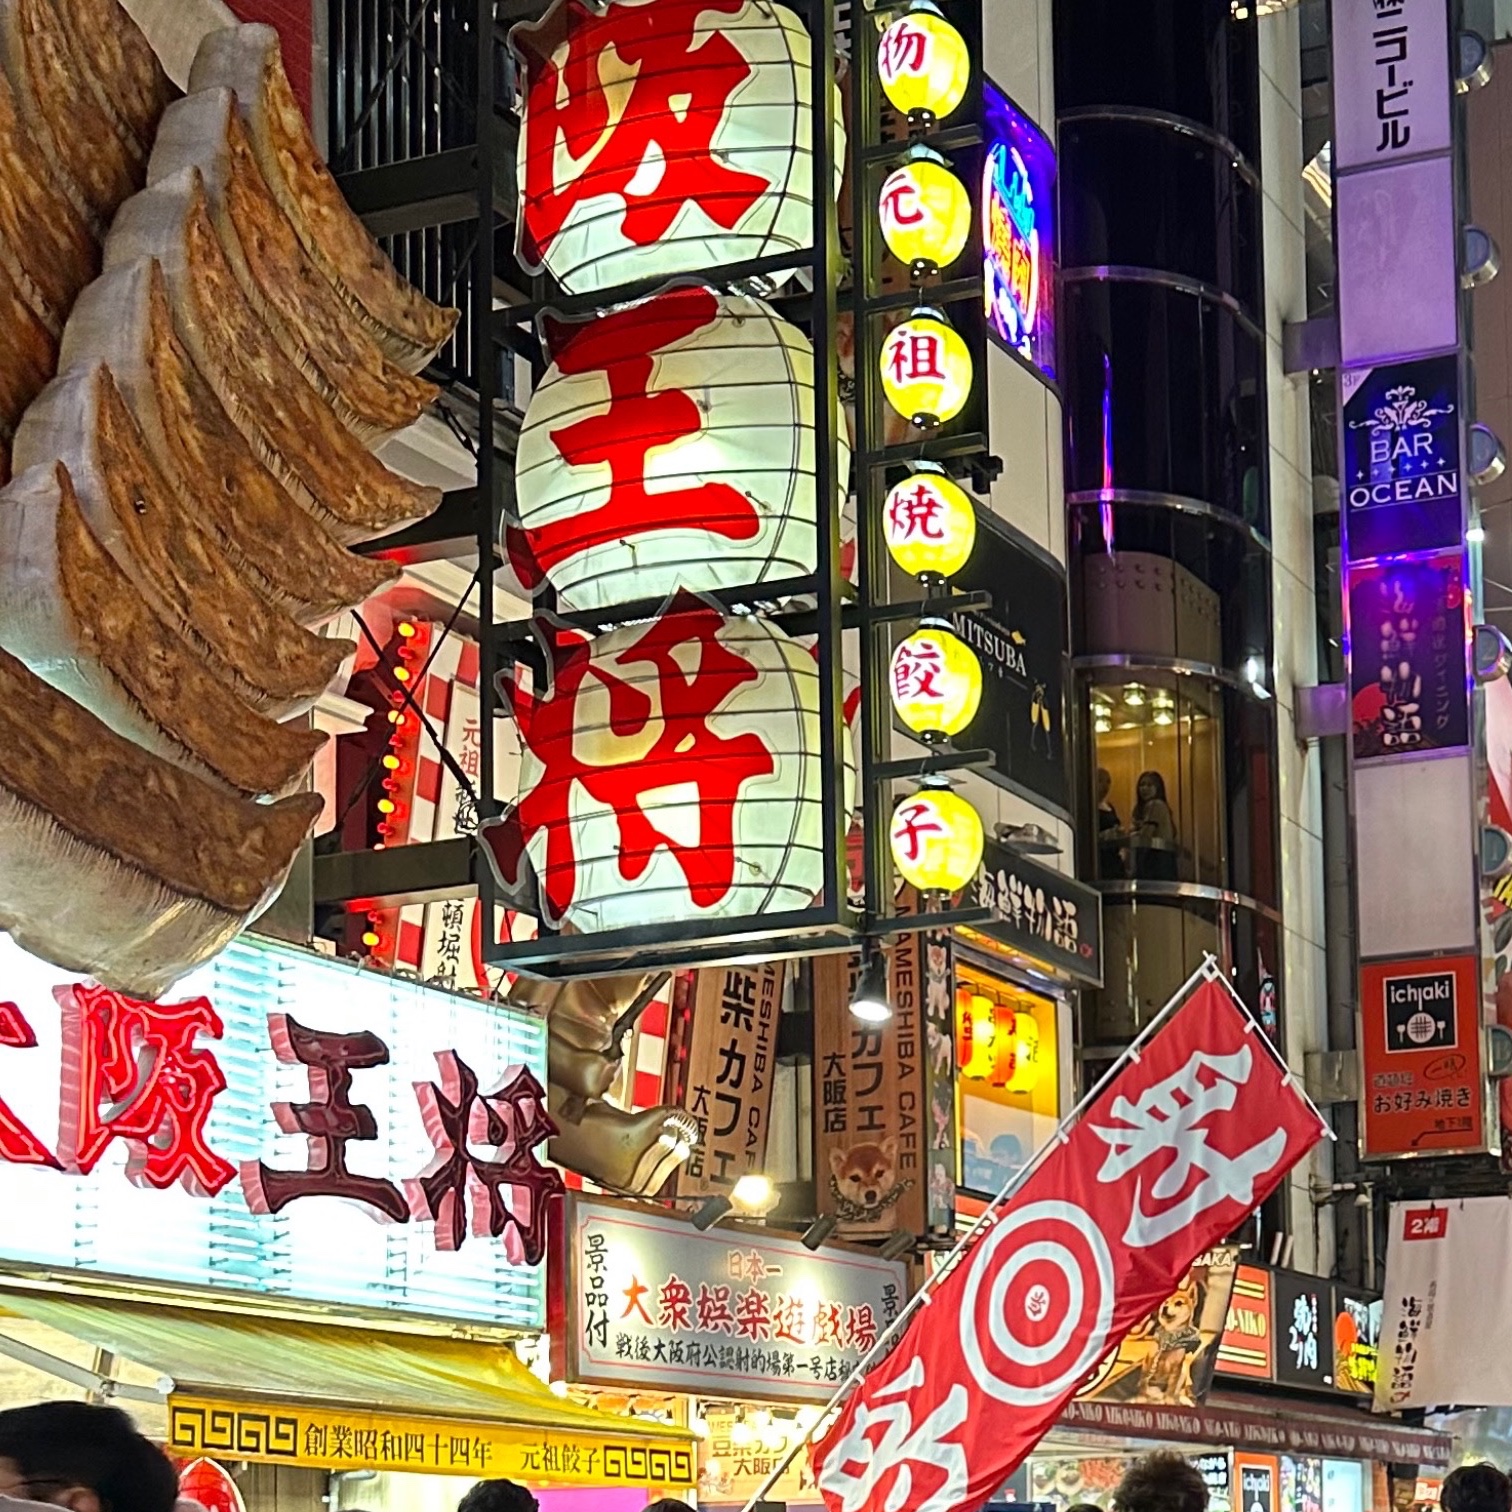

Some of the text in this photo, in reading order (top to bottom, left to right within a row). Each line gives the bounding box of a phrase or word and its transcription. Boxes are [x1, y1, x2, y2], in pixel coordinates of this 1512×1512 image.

[1373, 0, 1414, 152] ニコービル
[1370, 432, 1434, 464] BAR
[1350, 472, 1458, 508] OCEAN
[952, 611, 1029, 678] MITSUBA
[459, 718, 482, 777] 元祖
[1390, 981, 1450, 1008] ichiaki
[822, 1051, 848, 1134] 大阪店
[1373, 1087, 1472, 1114] お好み焼き
[744, 1106, 762, 1168] CAF
[899, 1091, 918, 1170] CAFE
[584, 1233, 610, 1349] 景品付
[728, 1250, 784, 1283] 日本一
[619, 1273, 880, 1354] 大衆娯楽遊戯場
[615, 1331, 852, 1384] 戦後大阪府公認射的場第一号店
[303, 1422, 602, 1477] 創業昭和四十四年 元祖餃子
